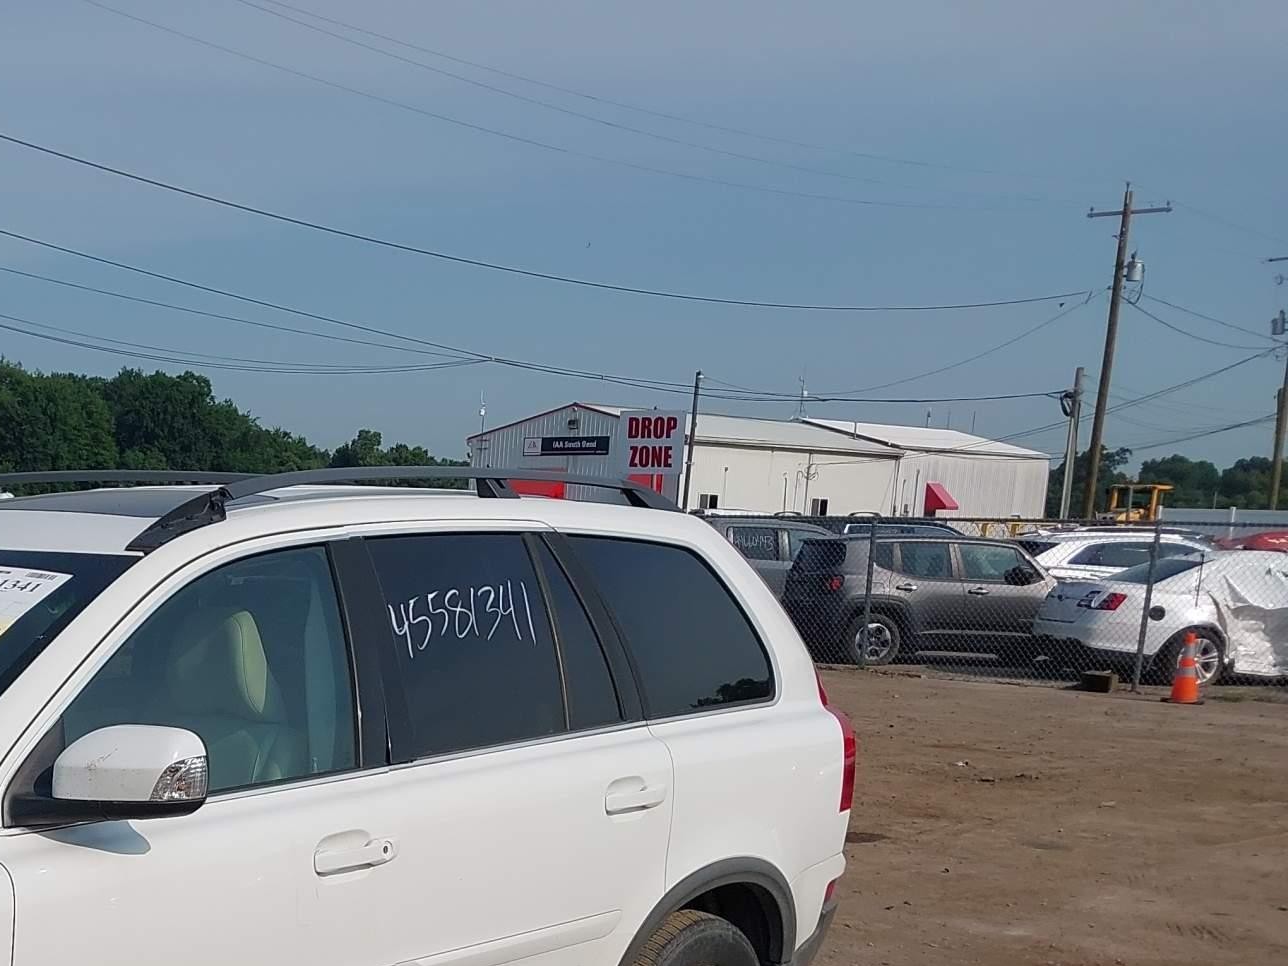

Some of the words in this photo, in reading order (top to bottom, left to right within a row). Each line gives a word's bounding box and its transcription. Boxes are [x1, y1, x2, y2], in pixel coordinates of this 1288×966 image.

[628, 416, 678, 439] DROP
[629, 445, 673, 467] ZONE
[388, 579, 537, 659] 45581341
